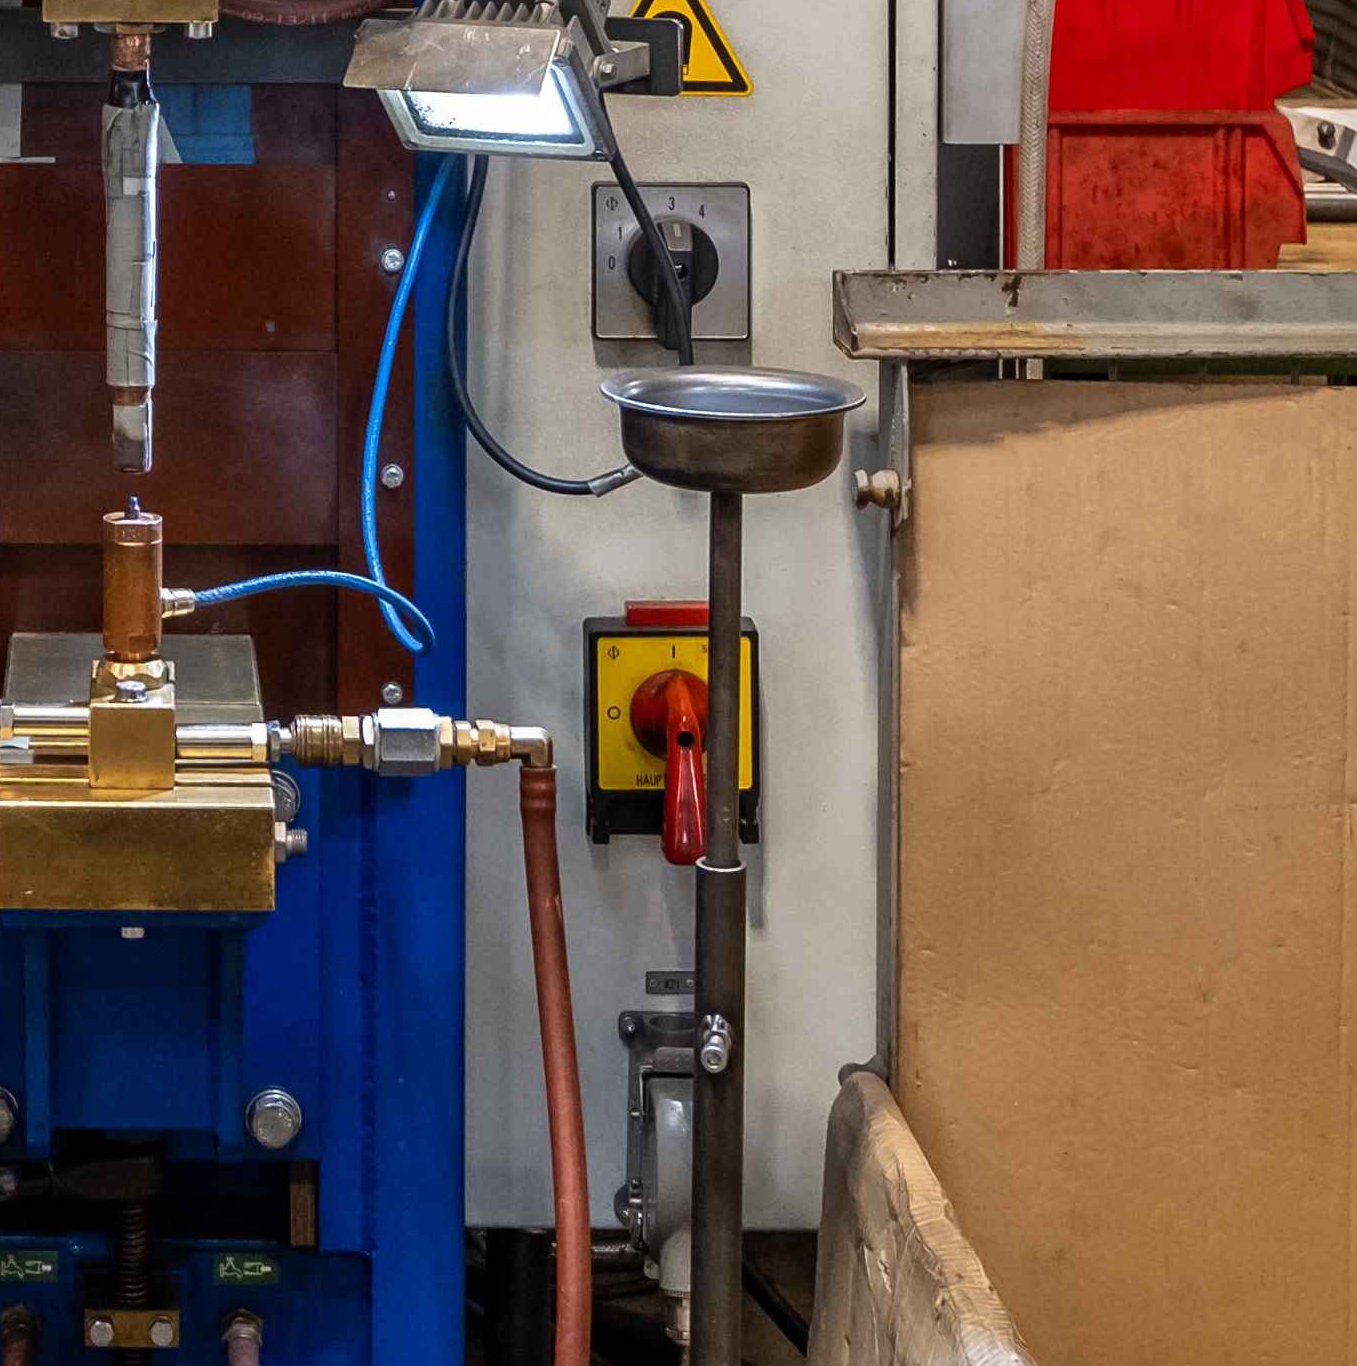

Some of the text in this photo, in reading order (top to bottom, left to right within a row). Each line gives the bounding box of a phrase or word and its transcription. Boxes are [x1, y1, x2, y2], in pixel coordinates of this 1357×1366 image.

[668, 196, 676, 211] 3
[698, 204, 705, 219] 4
[617, 226, 623, 240] 1
